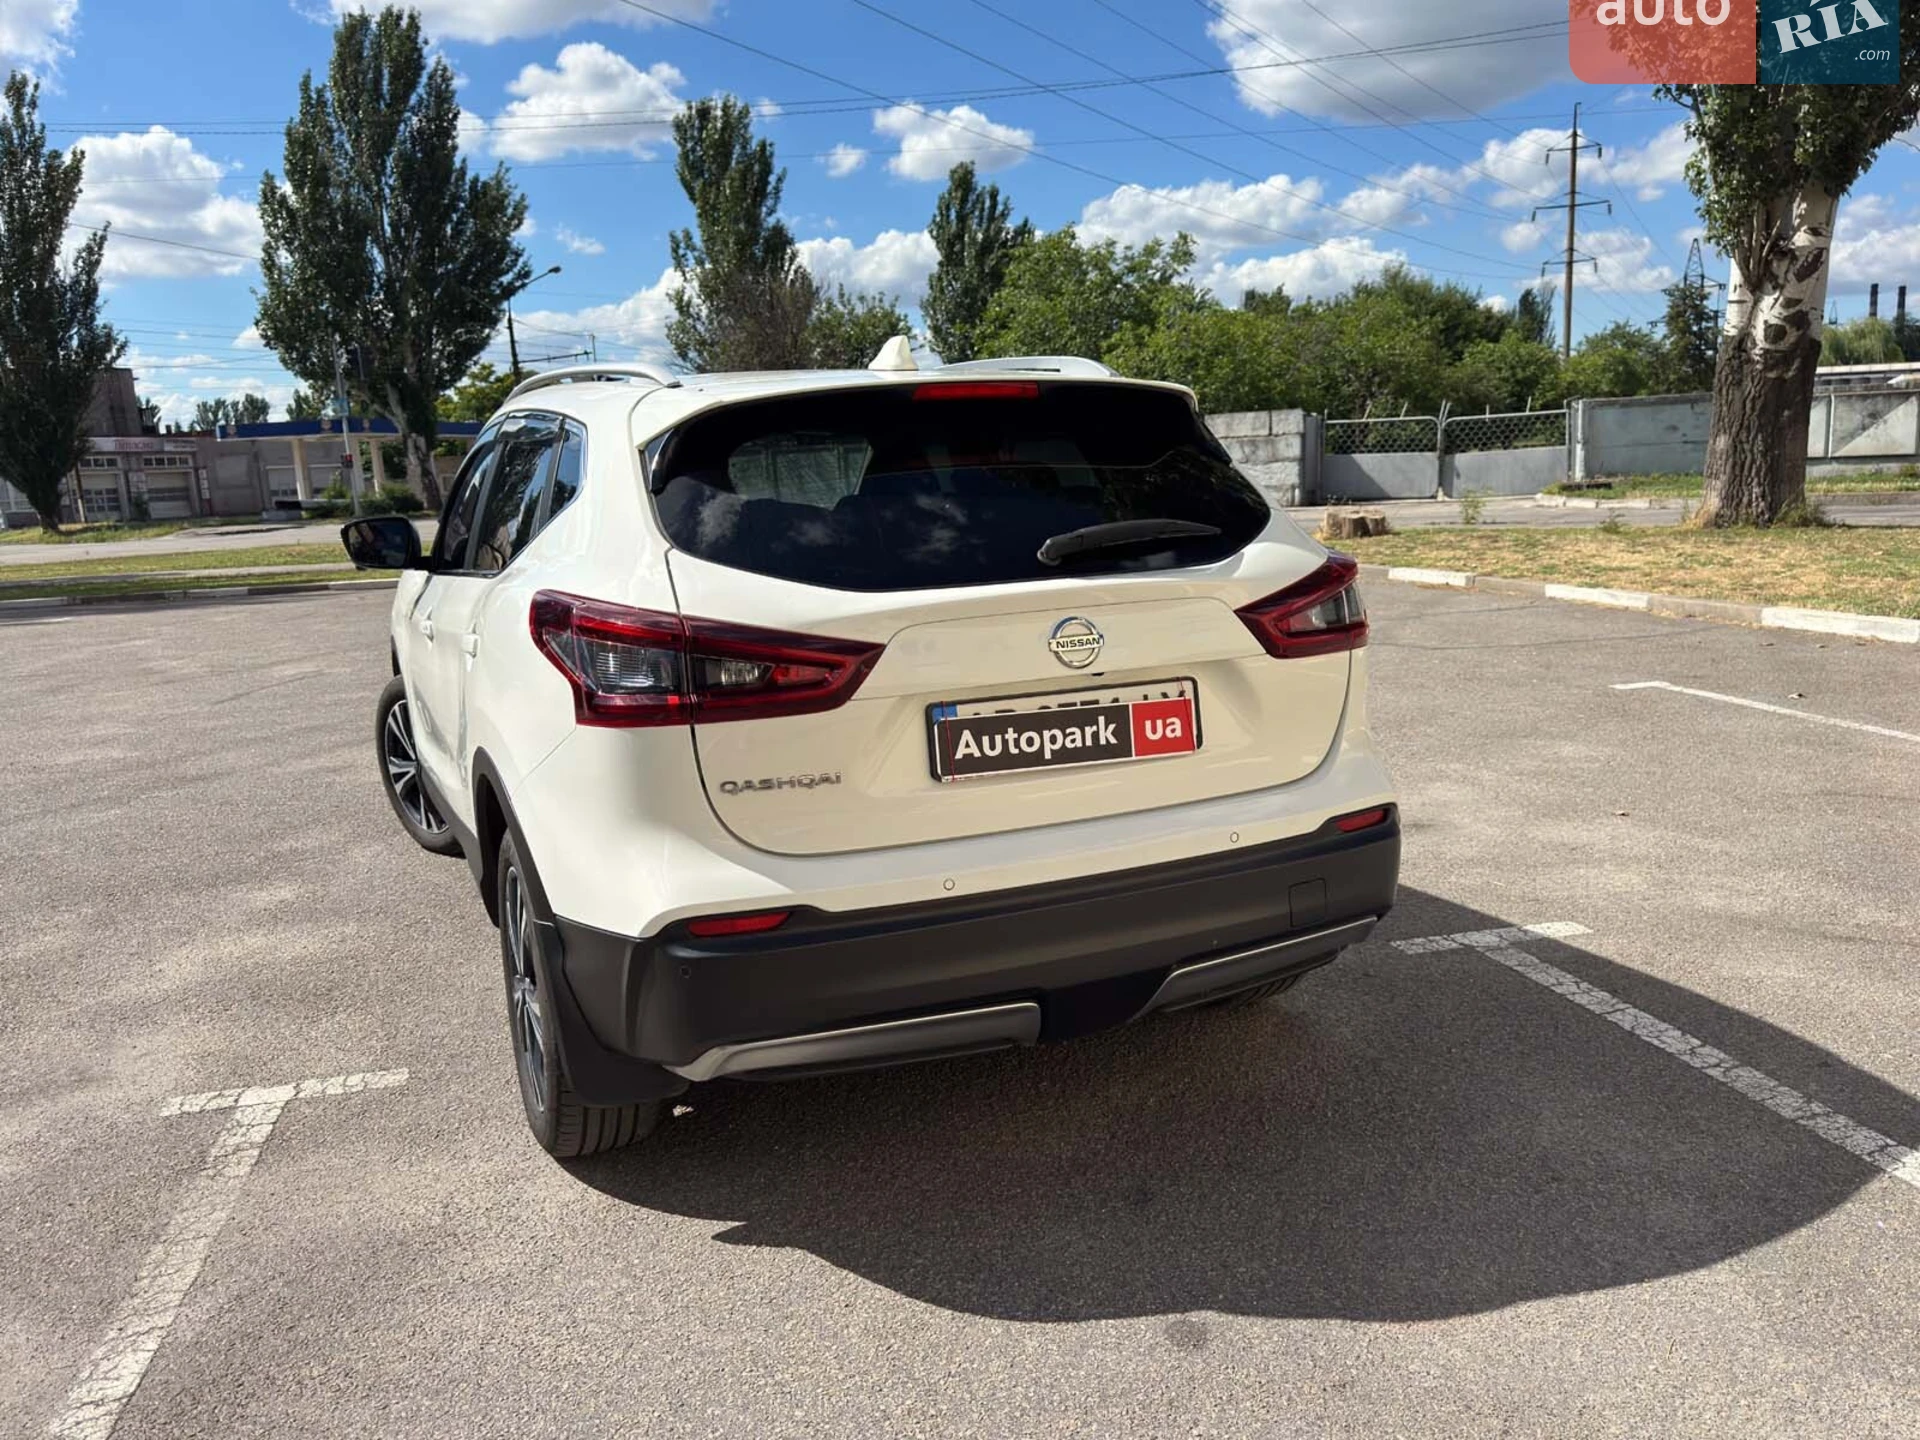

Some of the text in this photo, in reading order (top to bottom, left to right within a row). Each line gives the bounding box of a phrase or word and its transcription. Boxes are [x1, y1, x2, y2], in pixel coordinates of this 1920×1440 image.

[1056, 637, 1100, 649] NISSAN
[954, 715, 1183, 760] Autopark ua
